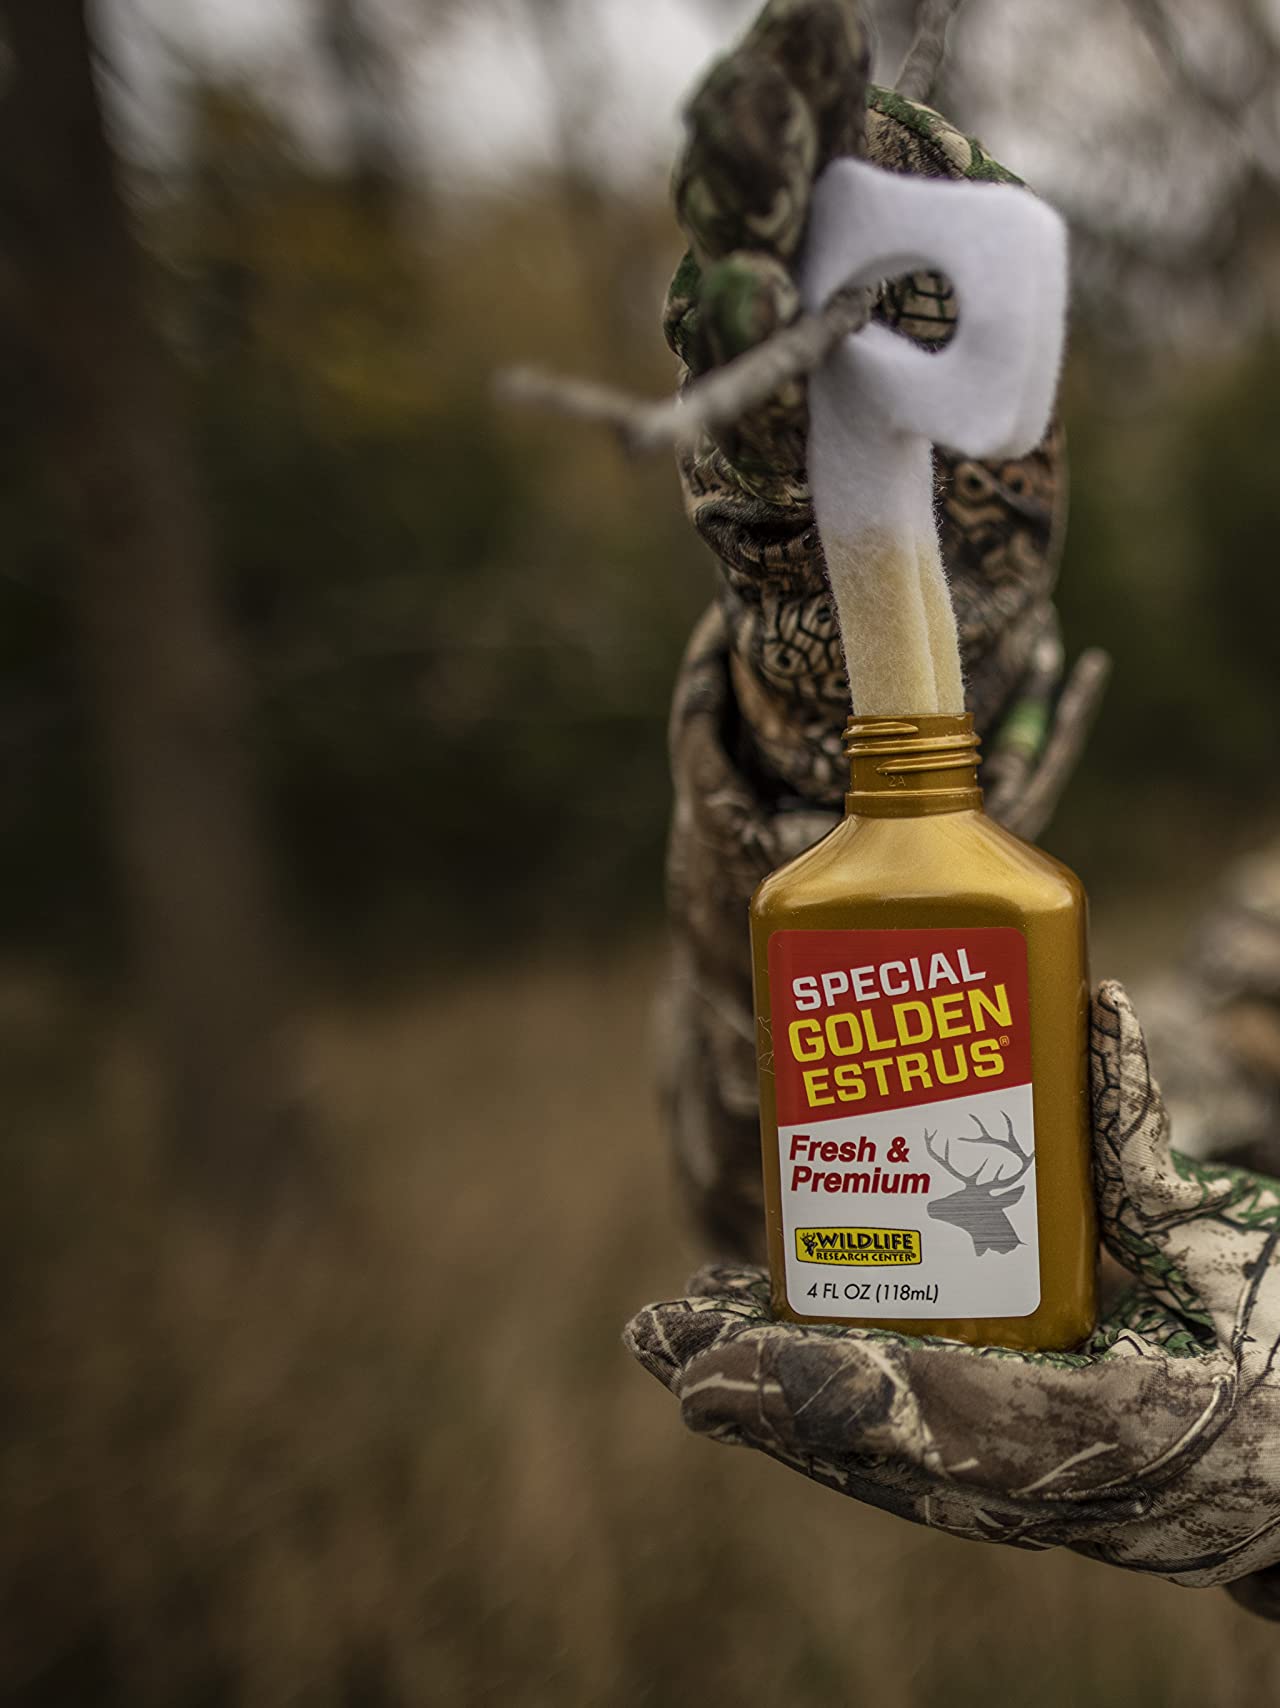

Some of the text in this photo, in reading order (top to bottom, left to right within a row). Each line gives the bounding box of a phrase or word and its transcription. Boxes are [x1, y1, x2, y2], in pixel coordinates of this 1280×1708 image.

[793, 948, 986, 1011] SPECIAL
[788, 984, 1012, 1062] GOLDEN
[789, 1135, 910, 1163] Fresh &
[791, 1166, 931, 1194] Premium
[816, 1232, 913, 1250] WILDLIFE
[816, 1252, 870, 1261] RESEARCH
[807, 1282, 939, 1303] 4 FL OZ (118mL)
